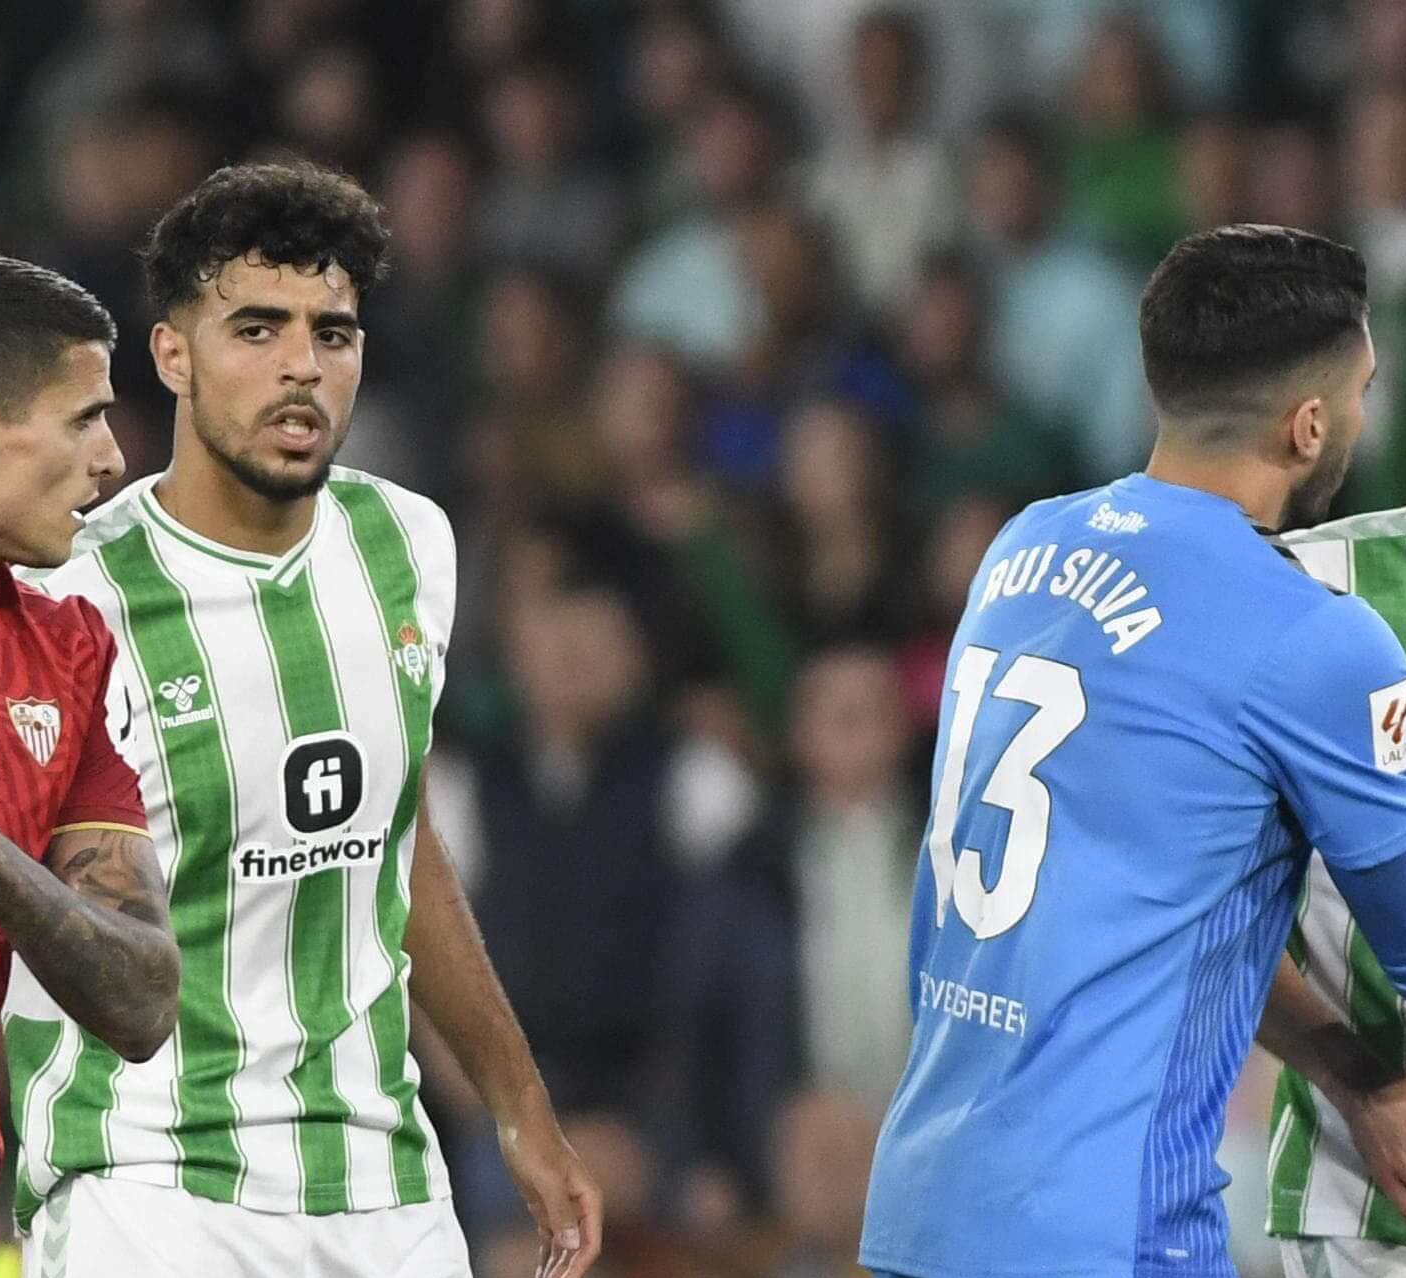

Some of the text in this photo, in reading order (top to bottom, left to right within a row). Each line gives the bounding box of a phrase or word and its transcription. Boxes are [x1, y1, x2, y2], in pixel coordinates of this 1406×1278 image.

[977, 544, 1163, 655] RUI SILVA
[303, 757, 343, 815] fi
[929, 645, 1087, 940] 13
